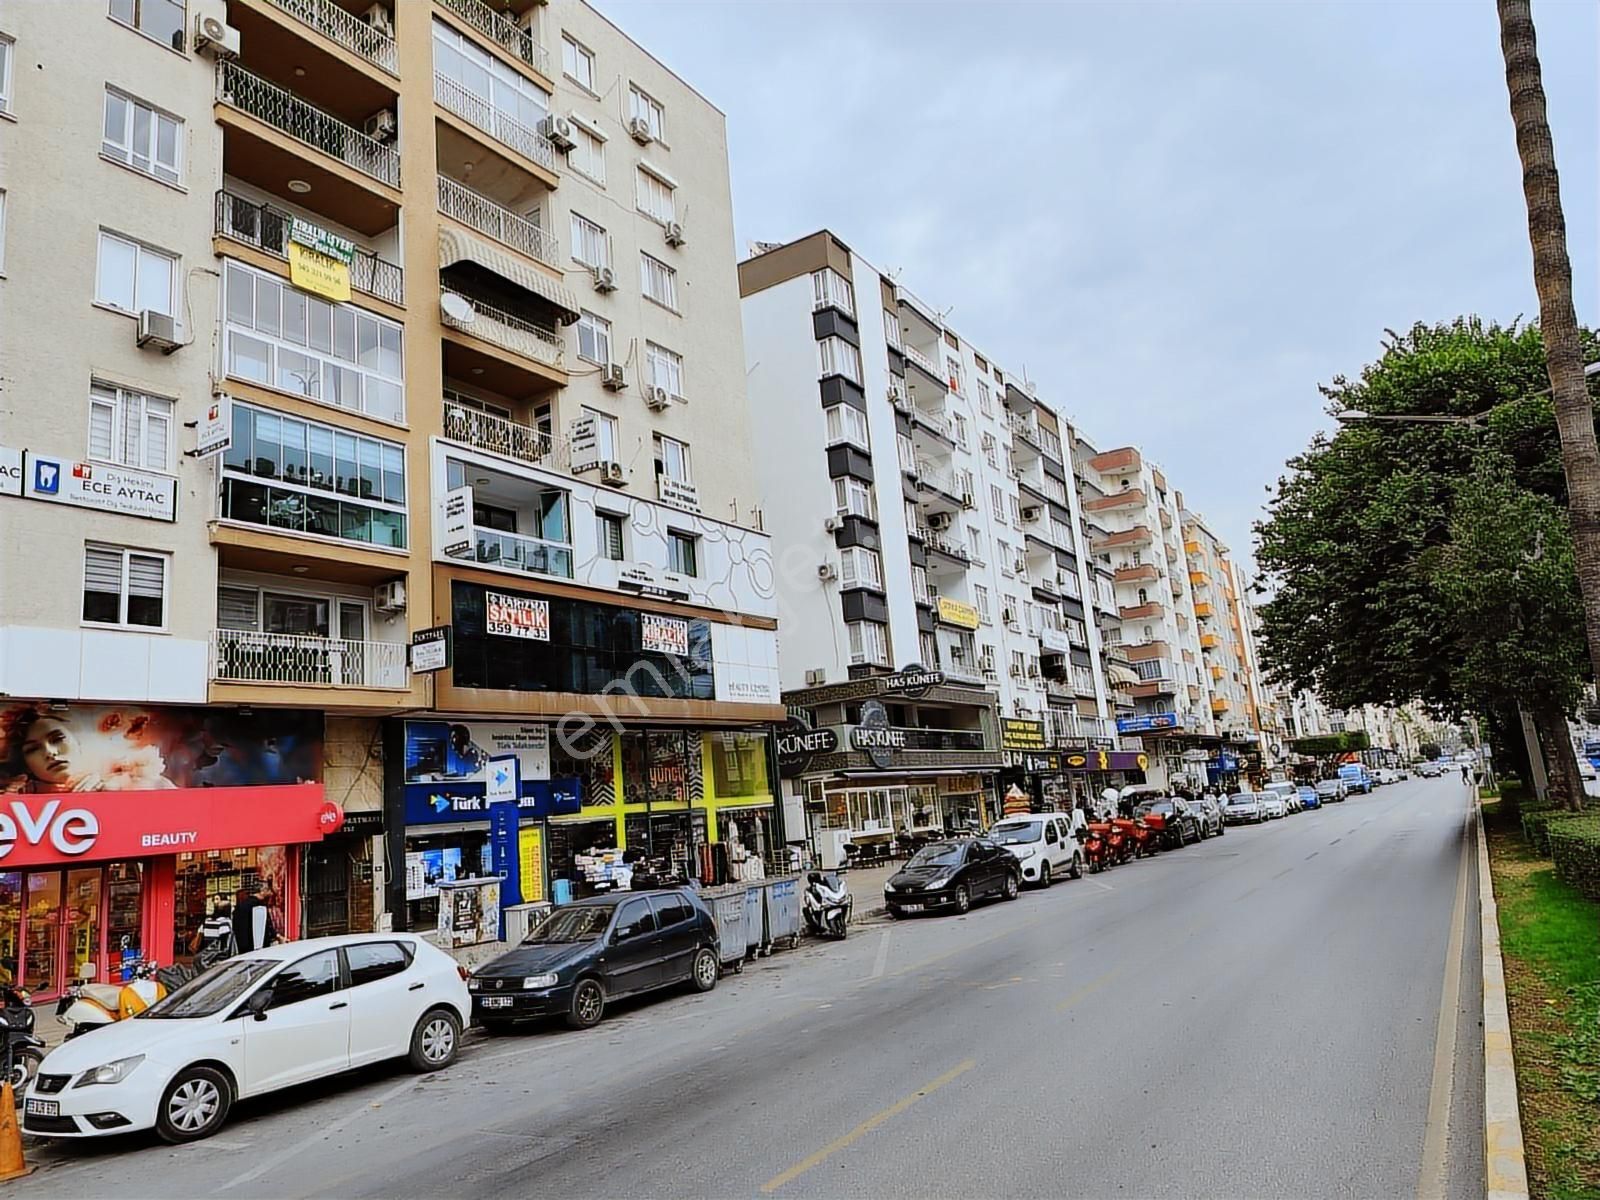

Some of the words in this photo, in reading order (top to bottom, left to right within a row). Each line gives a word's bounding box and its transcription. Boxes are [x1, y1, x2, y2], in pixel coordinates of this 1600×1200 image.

[82, 480, 112, 495] ECE
[488, 622, 512, 634] 359
[516, 626, 530, 636] 77
[534, 628, 547, 639] 33
[886, 678, 905, 689] HAS
[906, 672, 941, 687] KÜNEFE
[777, 732, 830, 755] KÜNEFE
[855, 729, 875, 747] HAS
[450, 796, 481, 811] Türk
[141, 832, 197, 847] BEAUTY
